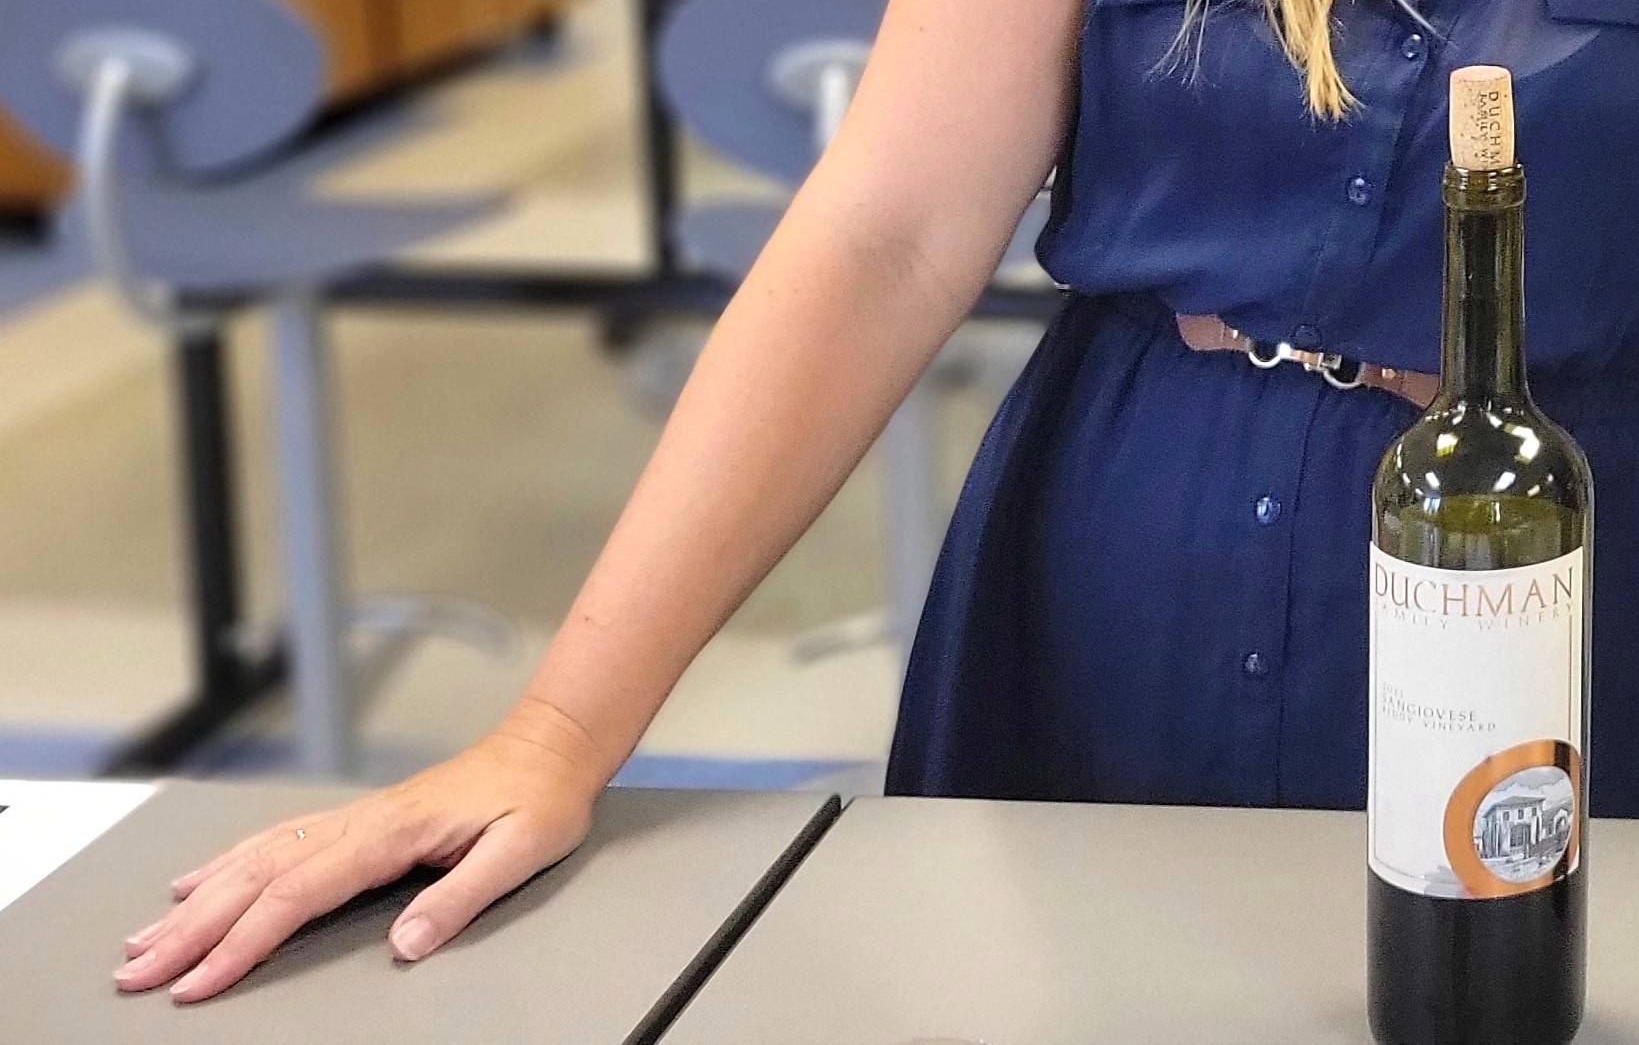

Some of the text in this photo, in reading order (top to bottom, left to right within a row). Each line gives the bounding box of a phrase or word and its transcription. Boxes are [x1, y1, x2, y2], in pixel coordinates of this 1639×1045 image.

[1488, 91, 1501, 164] DUCHM
[1375, 562, 1573, 617] DUCHMAN
[1382, 692, 1477, 722] SANGIOVESE
[1424, 720, 1496, 733] VINEYARD
